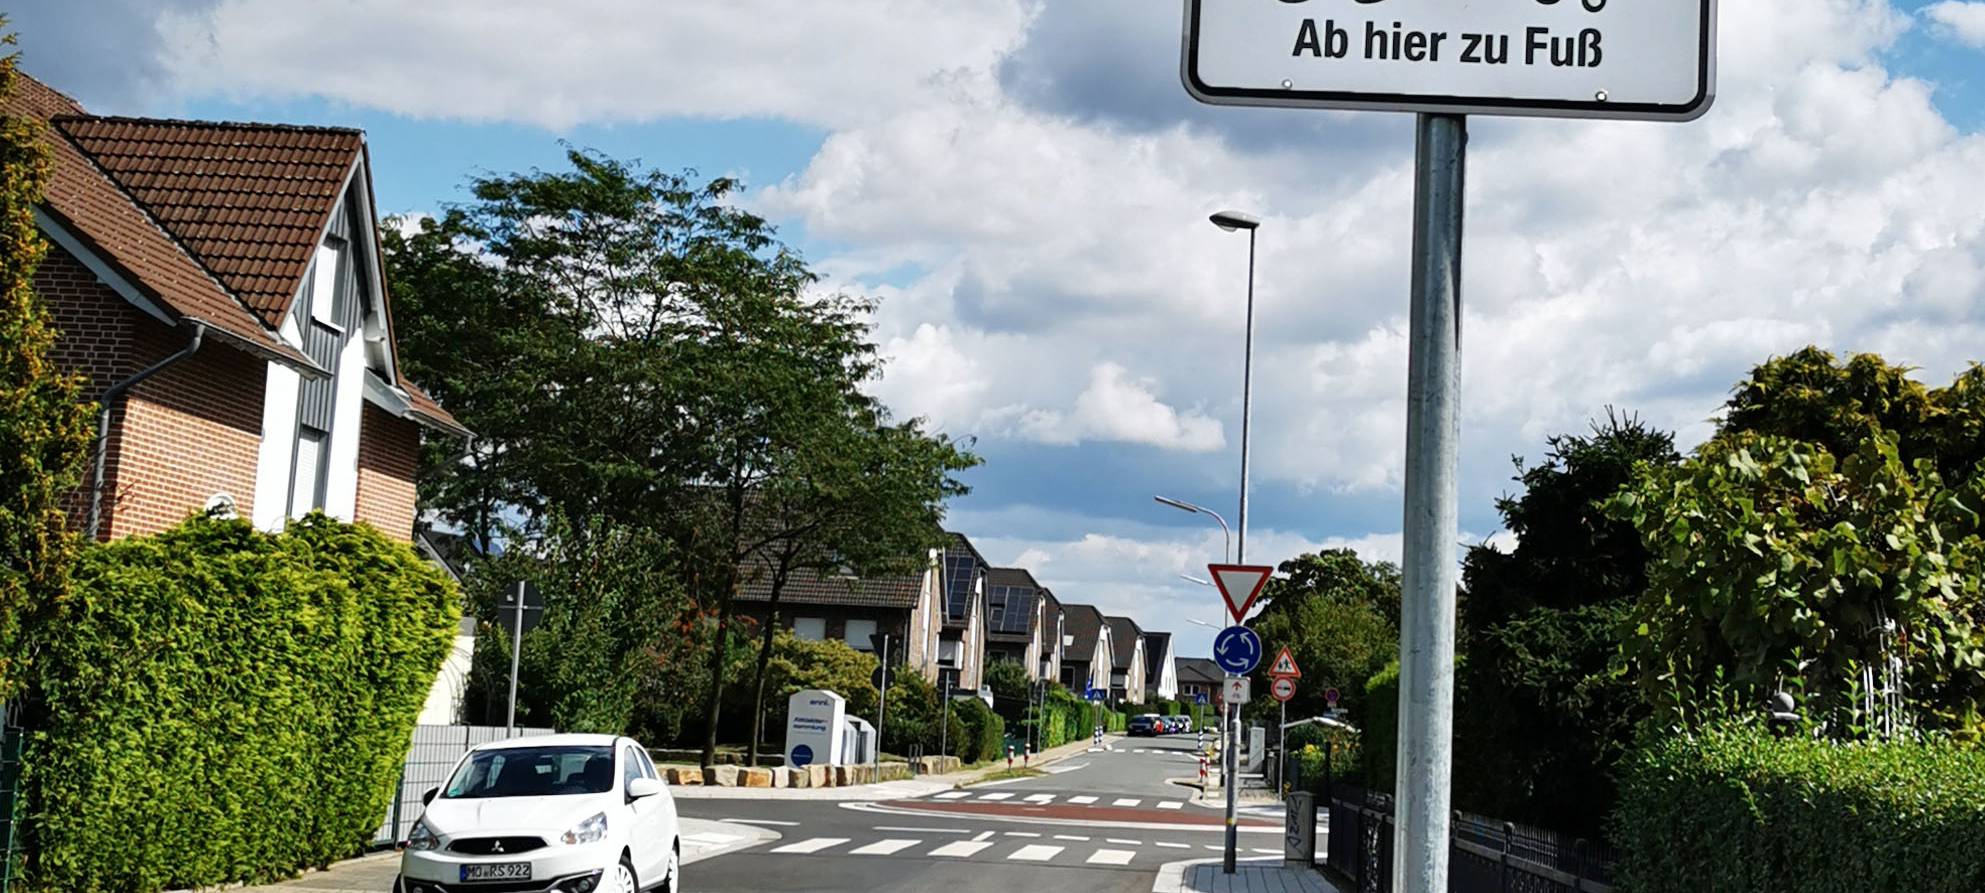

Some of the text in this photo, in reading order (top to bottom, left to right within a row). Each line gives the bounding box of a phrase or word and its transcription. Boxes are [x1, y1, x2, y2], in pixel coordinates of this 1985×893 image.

[1292, 18, 1603, 67] Ab hier zu Fuß
